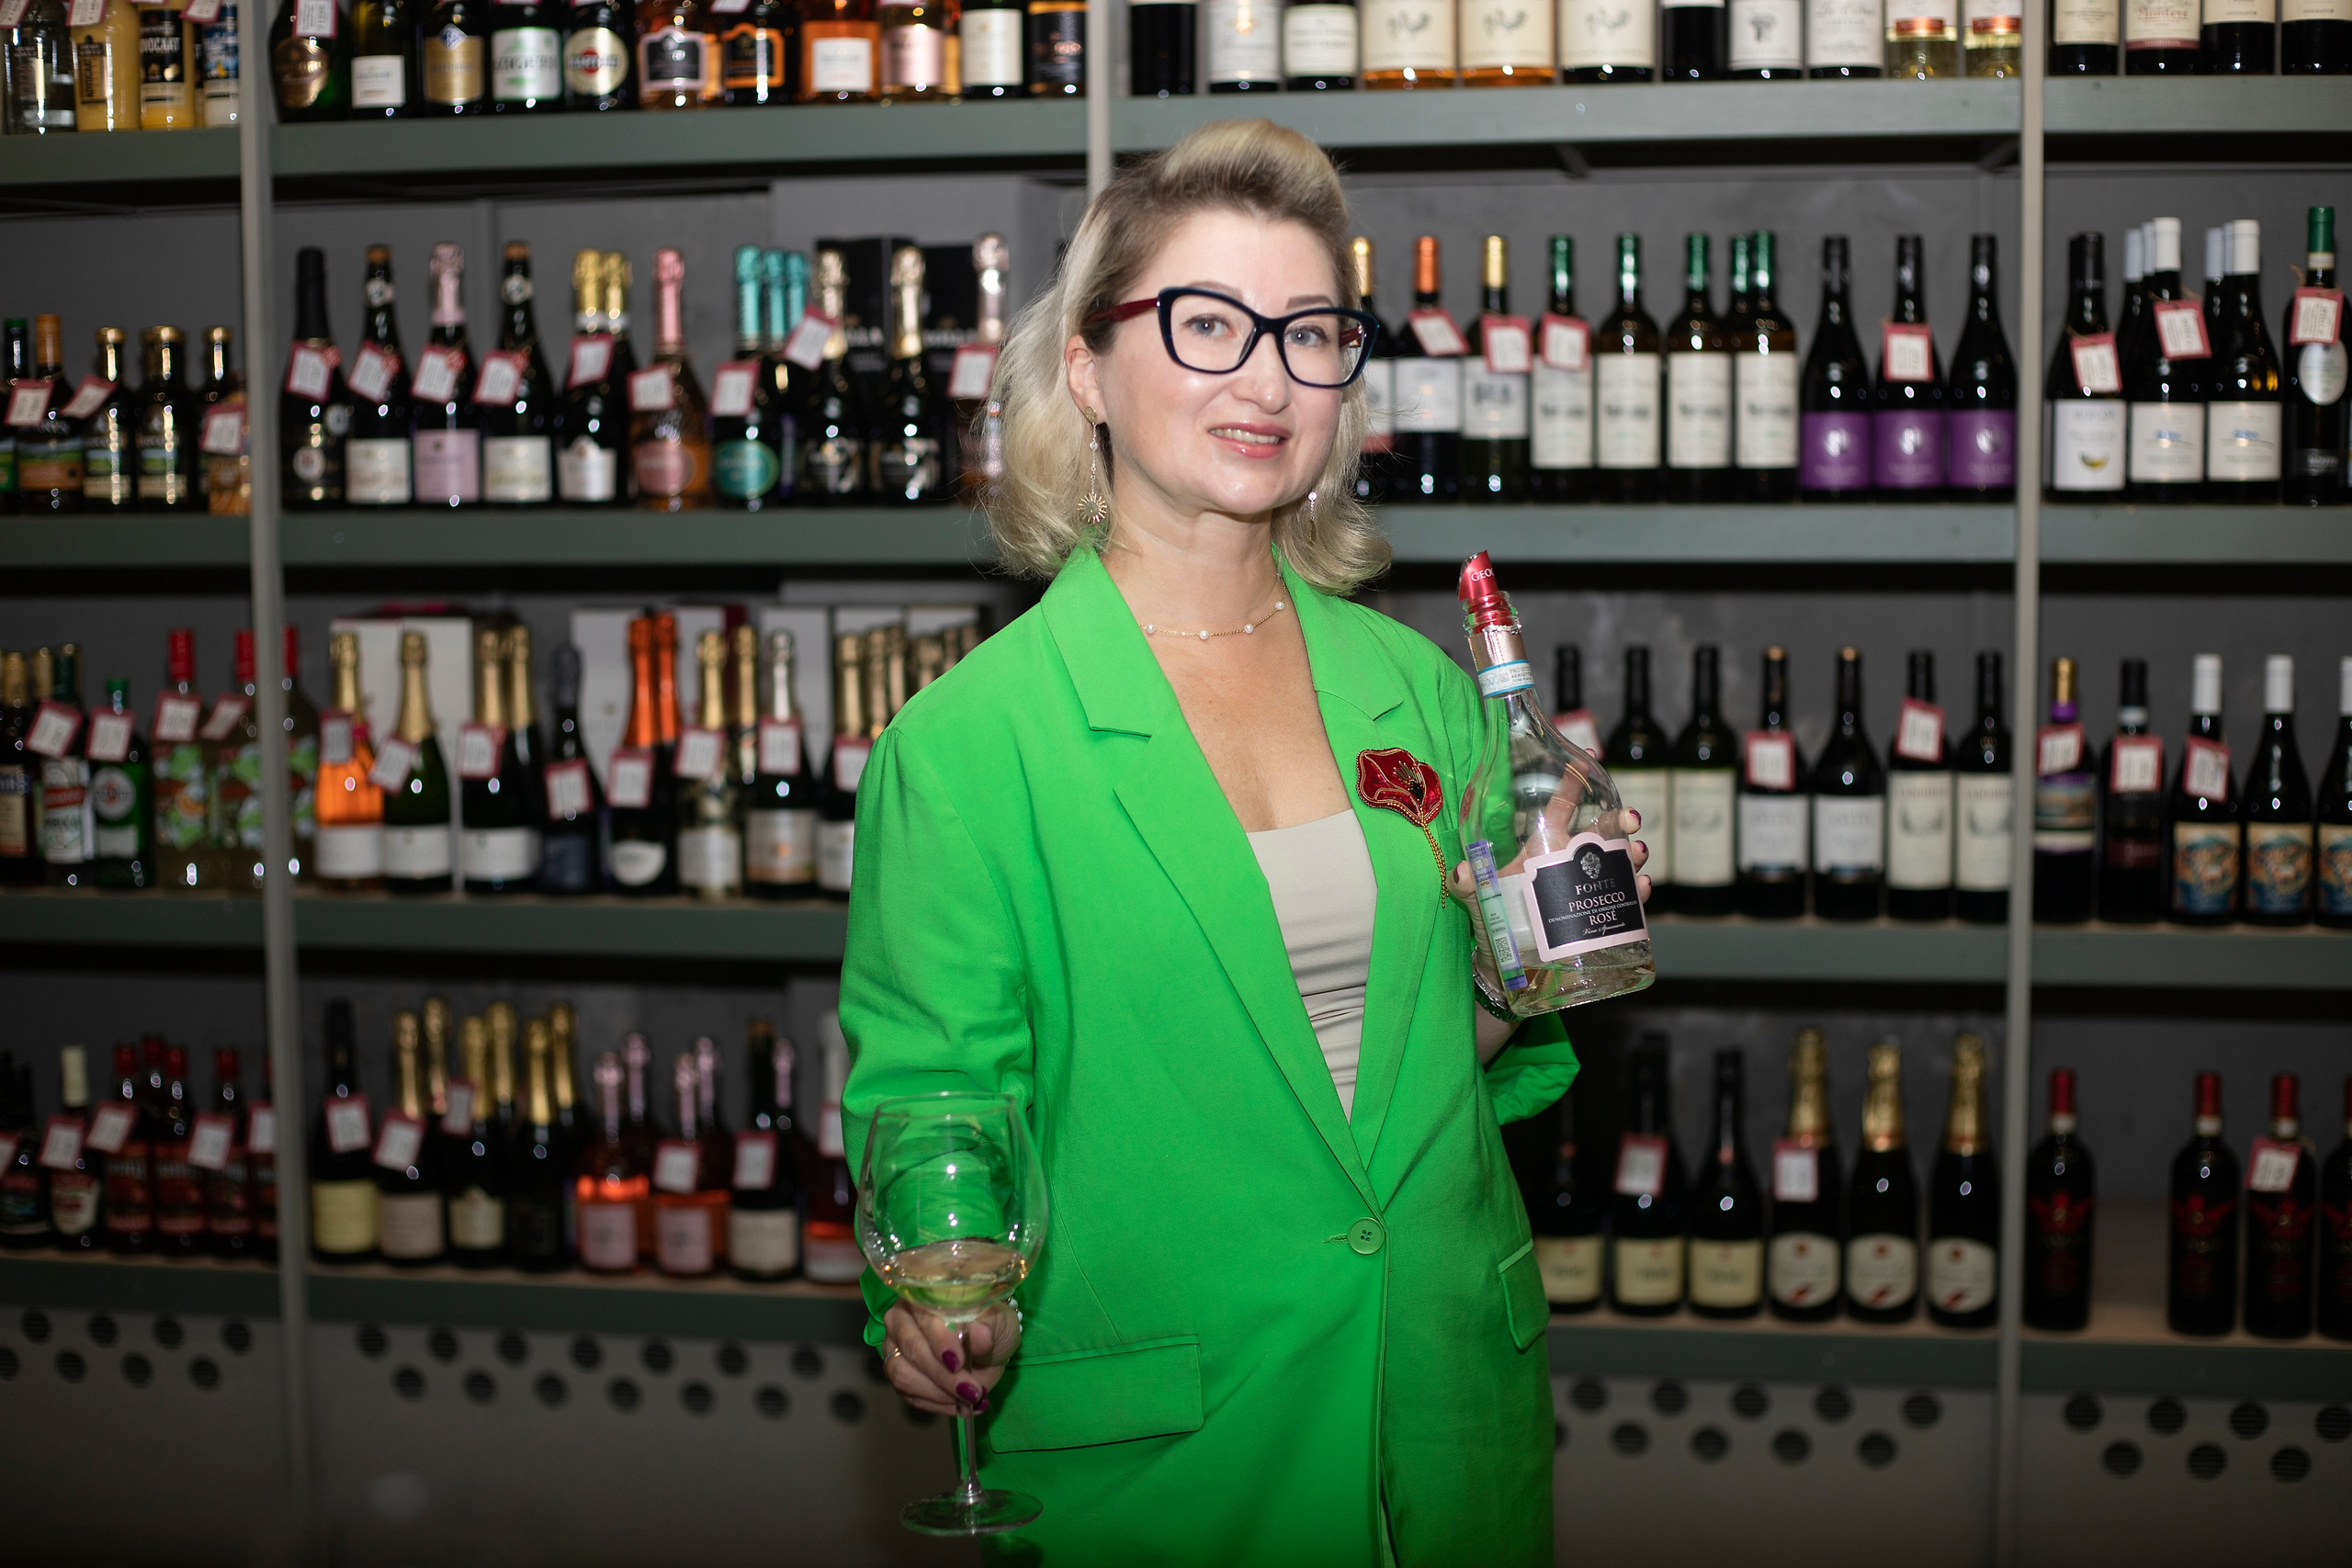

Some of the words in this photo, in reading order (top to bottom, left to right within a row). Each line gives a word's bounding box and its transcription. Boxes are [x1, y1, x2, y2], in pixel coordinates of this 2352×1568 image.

[1575, 878, 1616, 896] FONTE
[1568, 891, 1625, 912] PROSECCO
[1548, 909, 1591, 923] DENOMINAZIONE
[1598, 904, 1617, 913] ORIGINE
